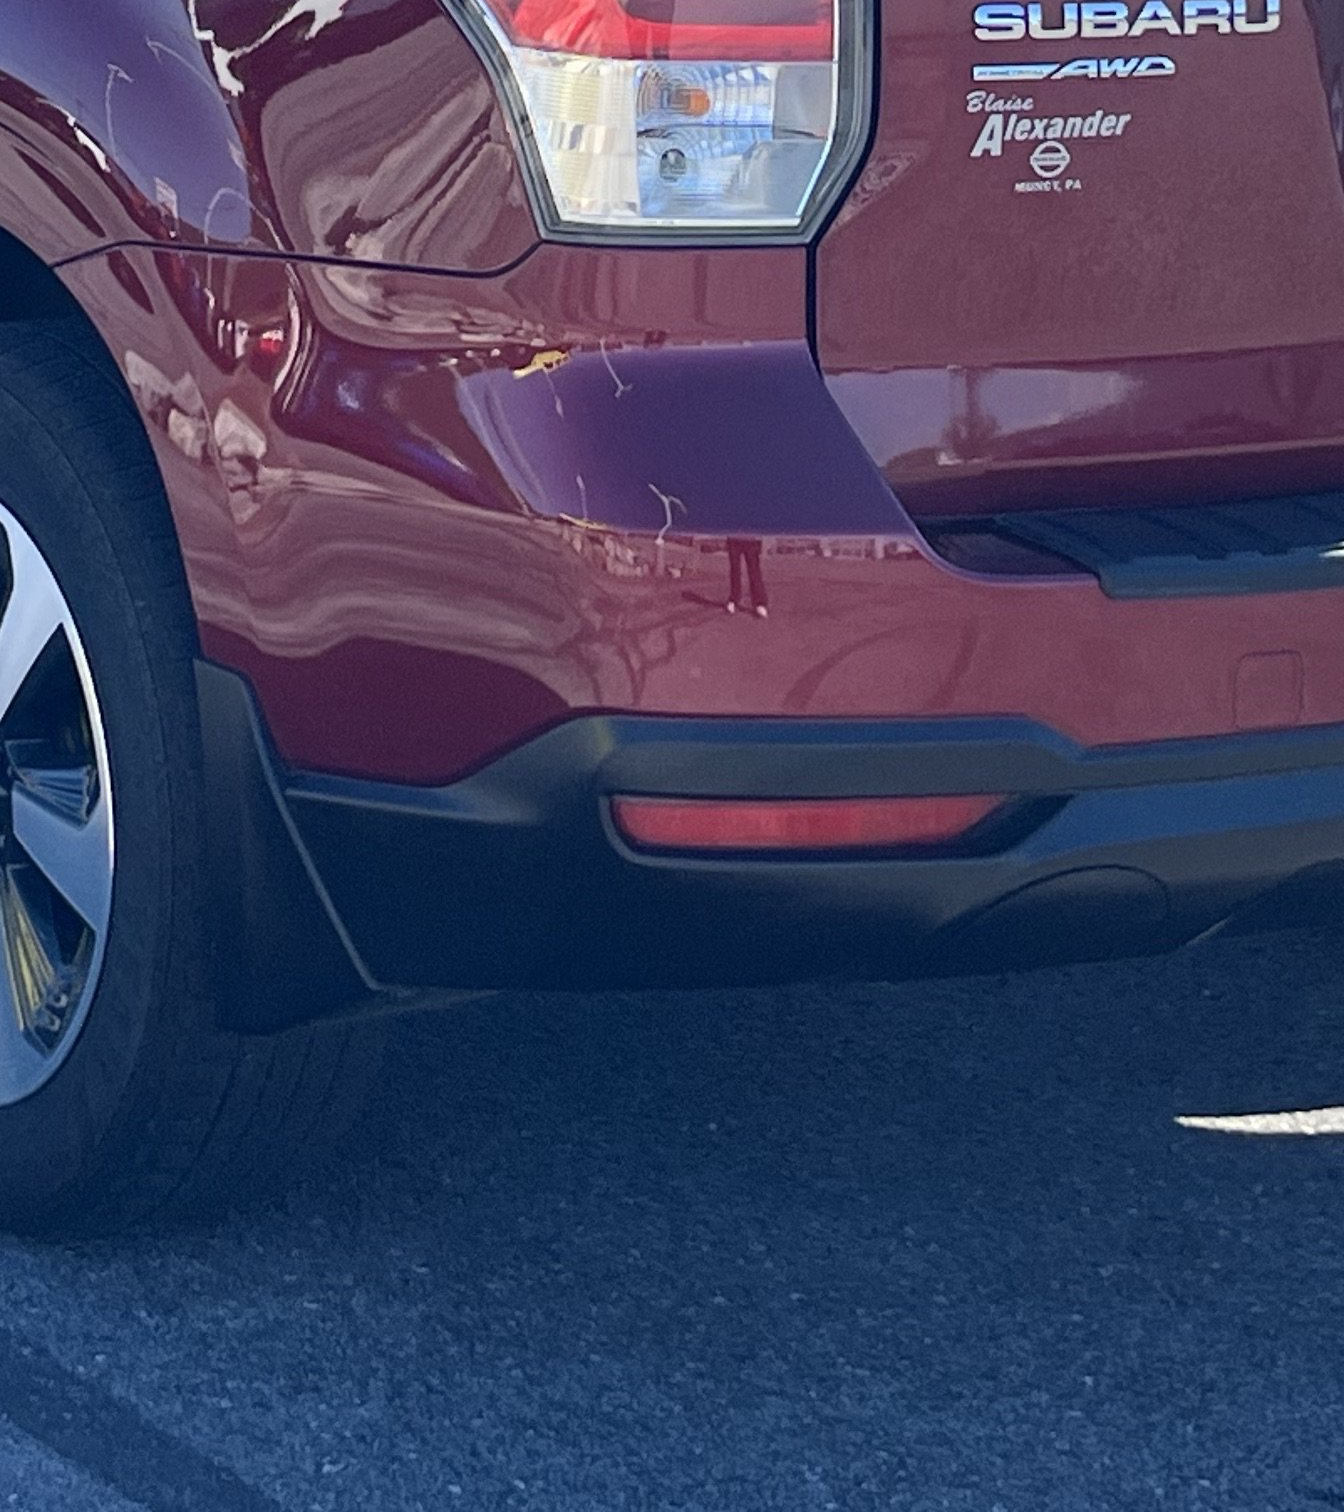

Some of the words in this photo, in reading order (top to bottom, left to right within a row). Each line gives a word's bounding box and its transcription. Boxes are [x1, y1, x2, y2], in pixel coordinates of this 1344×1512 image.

[1050, 55, 1176, 80] AWD
[966, 90, 1034, 113] Blaise
[970, 110, 1131, 158] Alexander
[1065, 178, 1082, 190] PA
